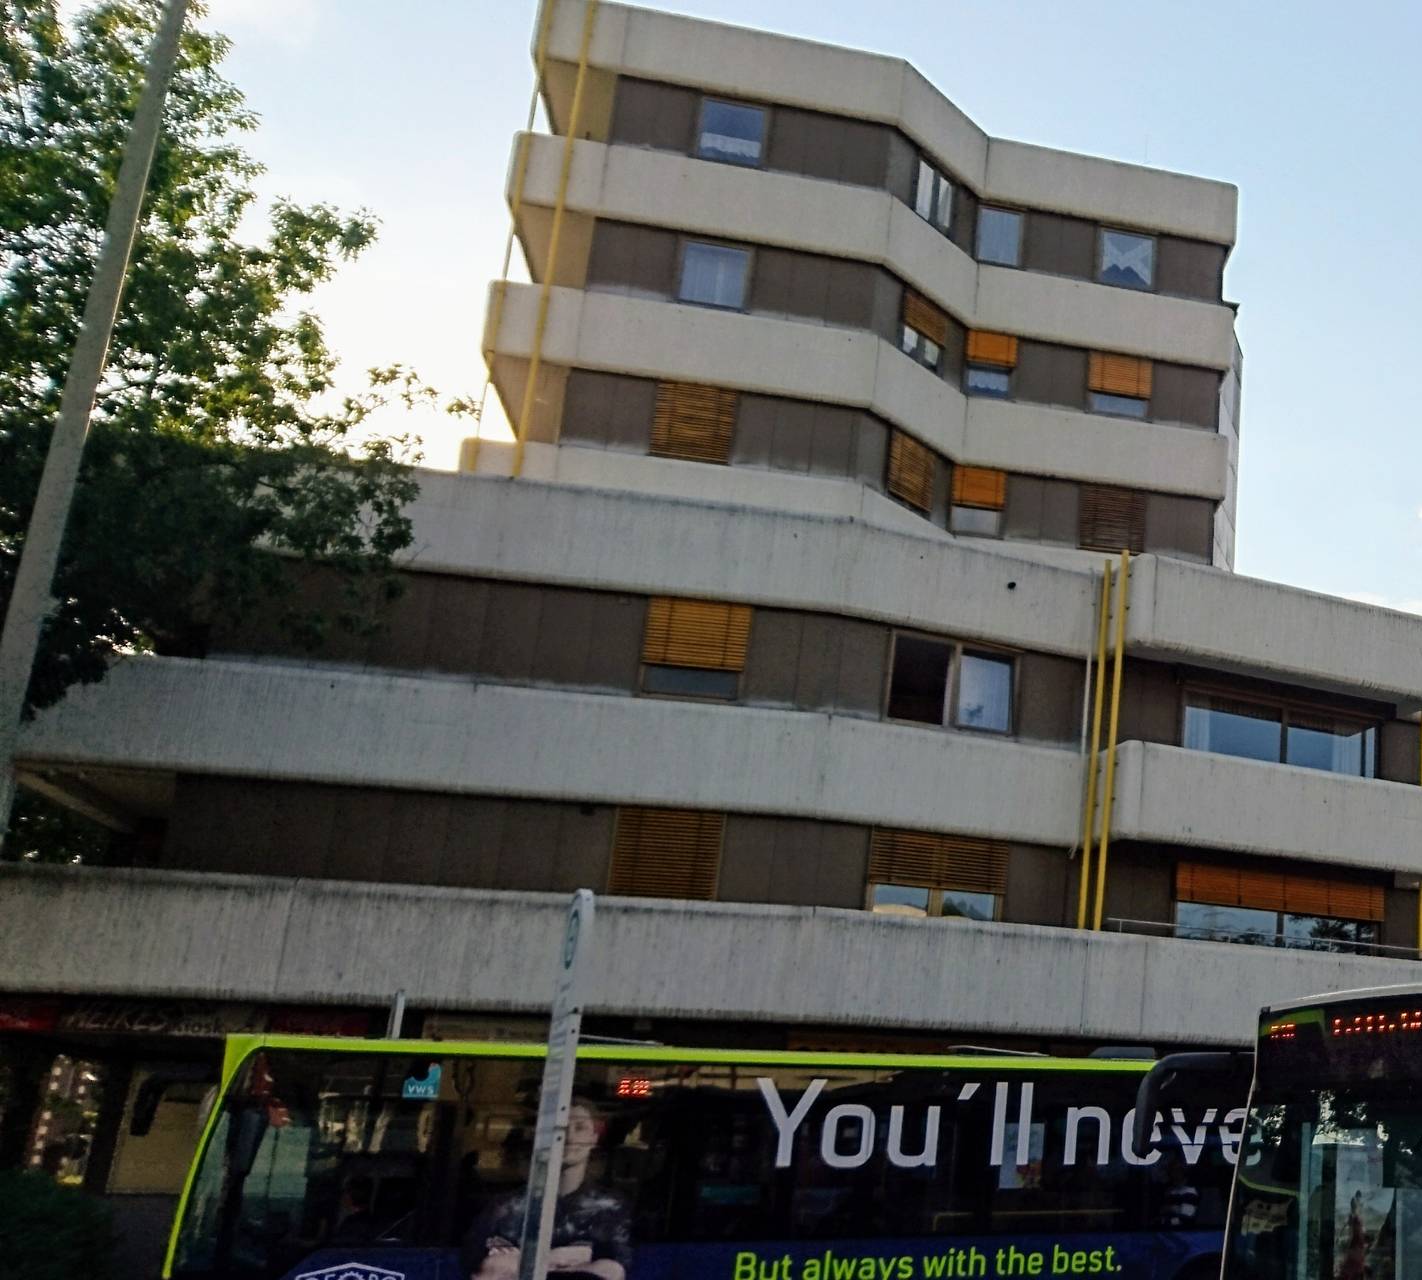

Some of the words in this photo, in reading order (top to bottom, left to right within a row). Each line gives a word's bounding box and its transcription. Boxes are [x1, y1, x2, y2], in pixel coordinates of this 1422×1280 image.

[408, 1084, 434, 1095] VWS
[734, 1251, 793, 1280] But
[802, 1250, 914, 1280] always
[922, 1247, 987, 1278] with
[996, 1245, 1044, 1276] the
[1052, 1243, 1123, 1274] best.
